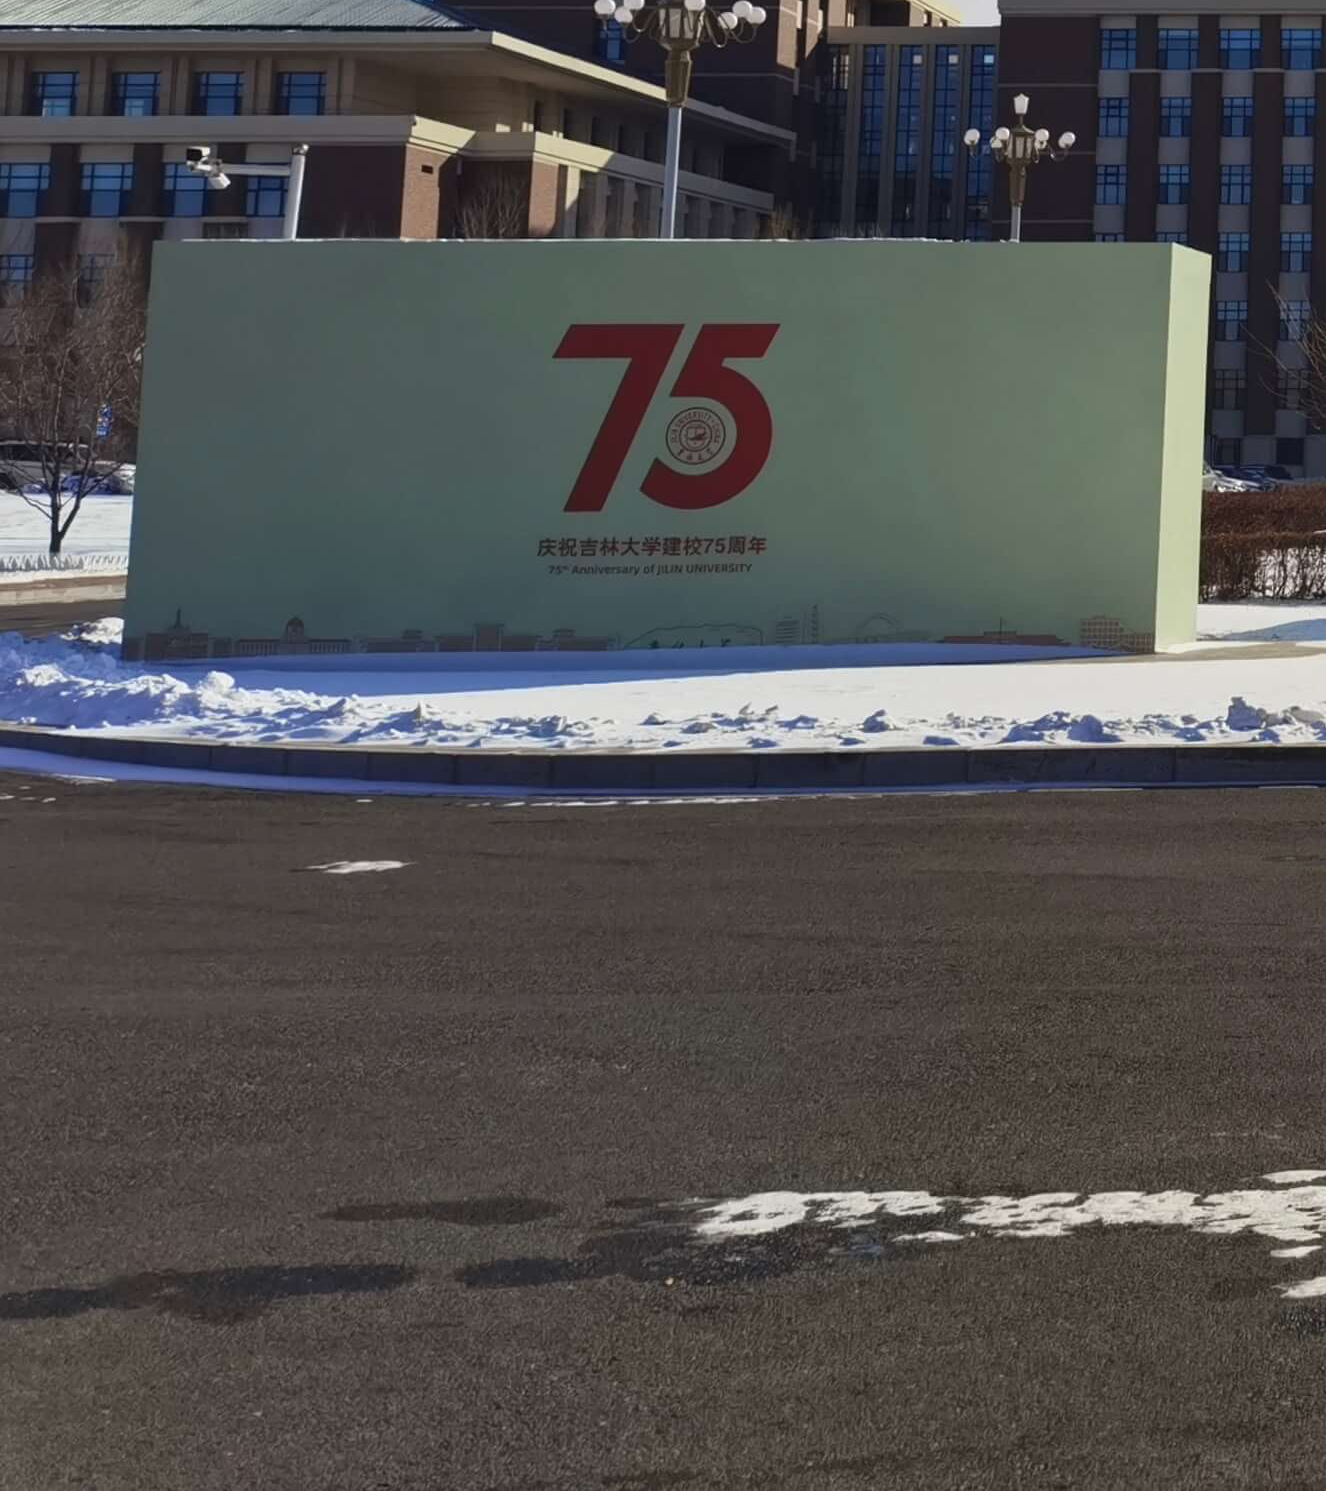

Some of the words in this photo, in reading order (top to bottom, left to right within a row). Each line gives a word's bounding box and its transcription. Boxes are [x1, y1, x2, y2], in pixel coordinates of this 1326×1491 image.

[552, 323, 781, 512] 75
[536, 535, 769, 557] 庆祝吉林大学建校75周年
[572, 565, 639, 576] Anniversary
[643, 564, 655, 575] of
[657, 564, 684, 575] JILIN
[686, 563, 753, 574] UNIVERSITY
